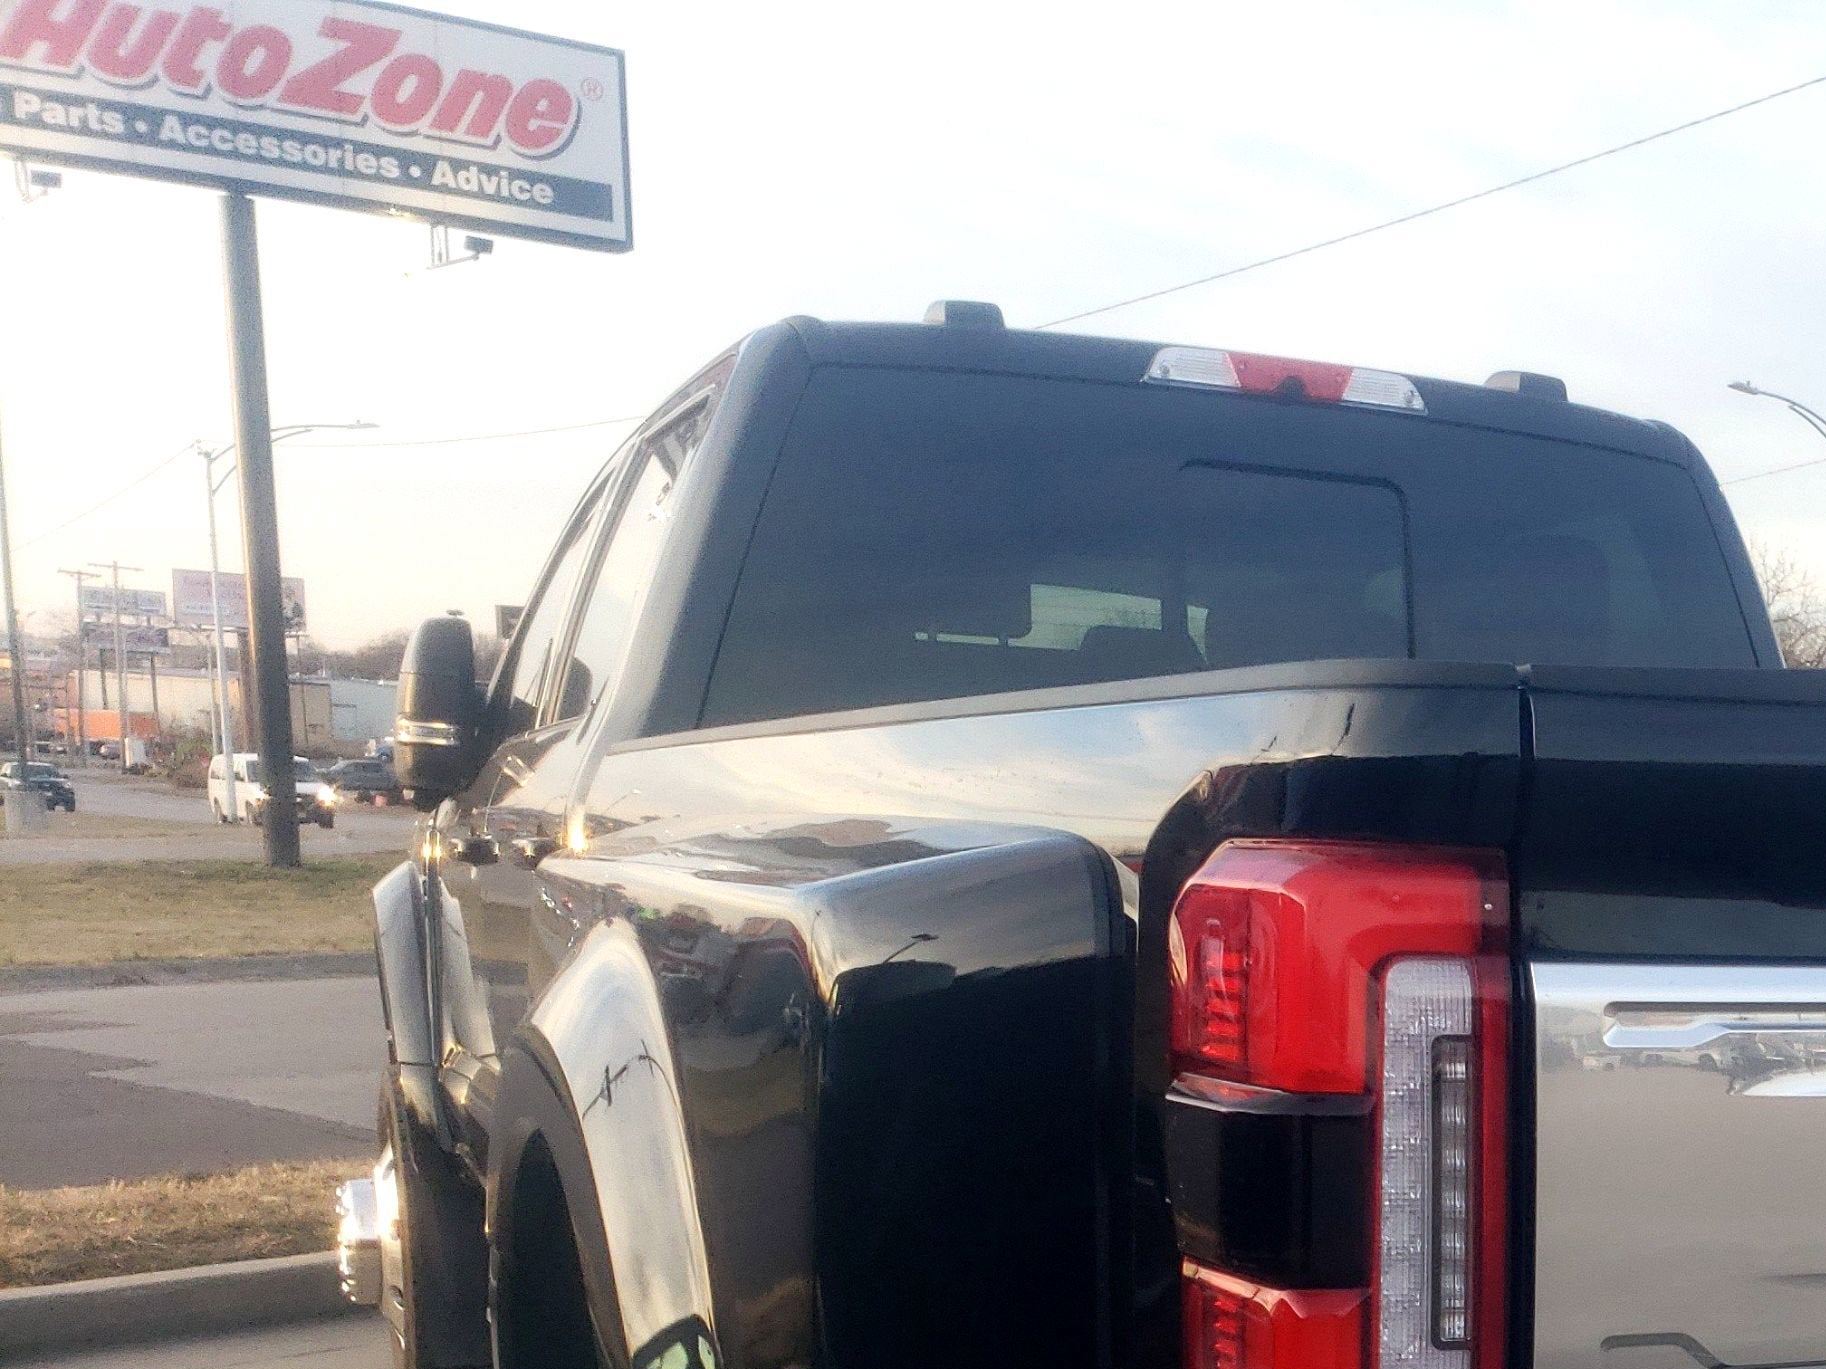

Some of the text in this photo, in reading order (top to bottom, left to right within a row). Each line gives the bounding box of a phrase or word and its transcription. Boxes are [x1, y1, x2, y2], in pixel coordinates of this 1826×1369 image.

[0, 0, 581, 157] AutoZone
[13, 90, 556, 206] Parts Accessories Advice
